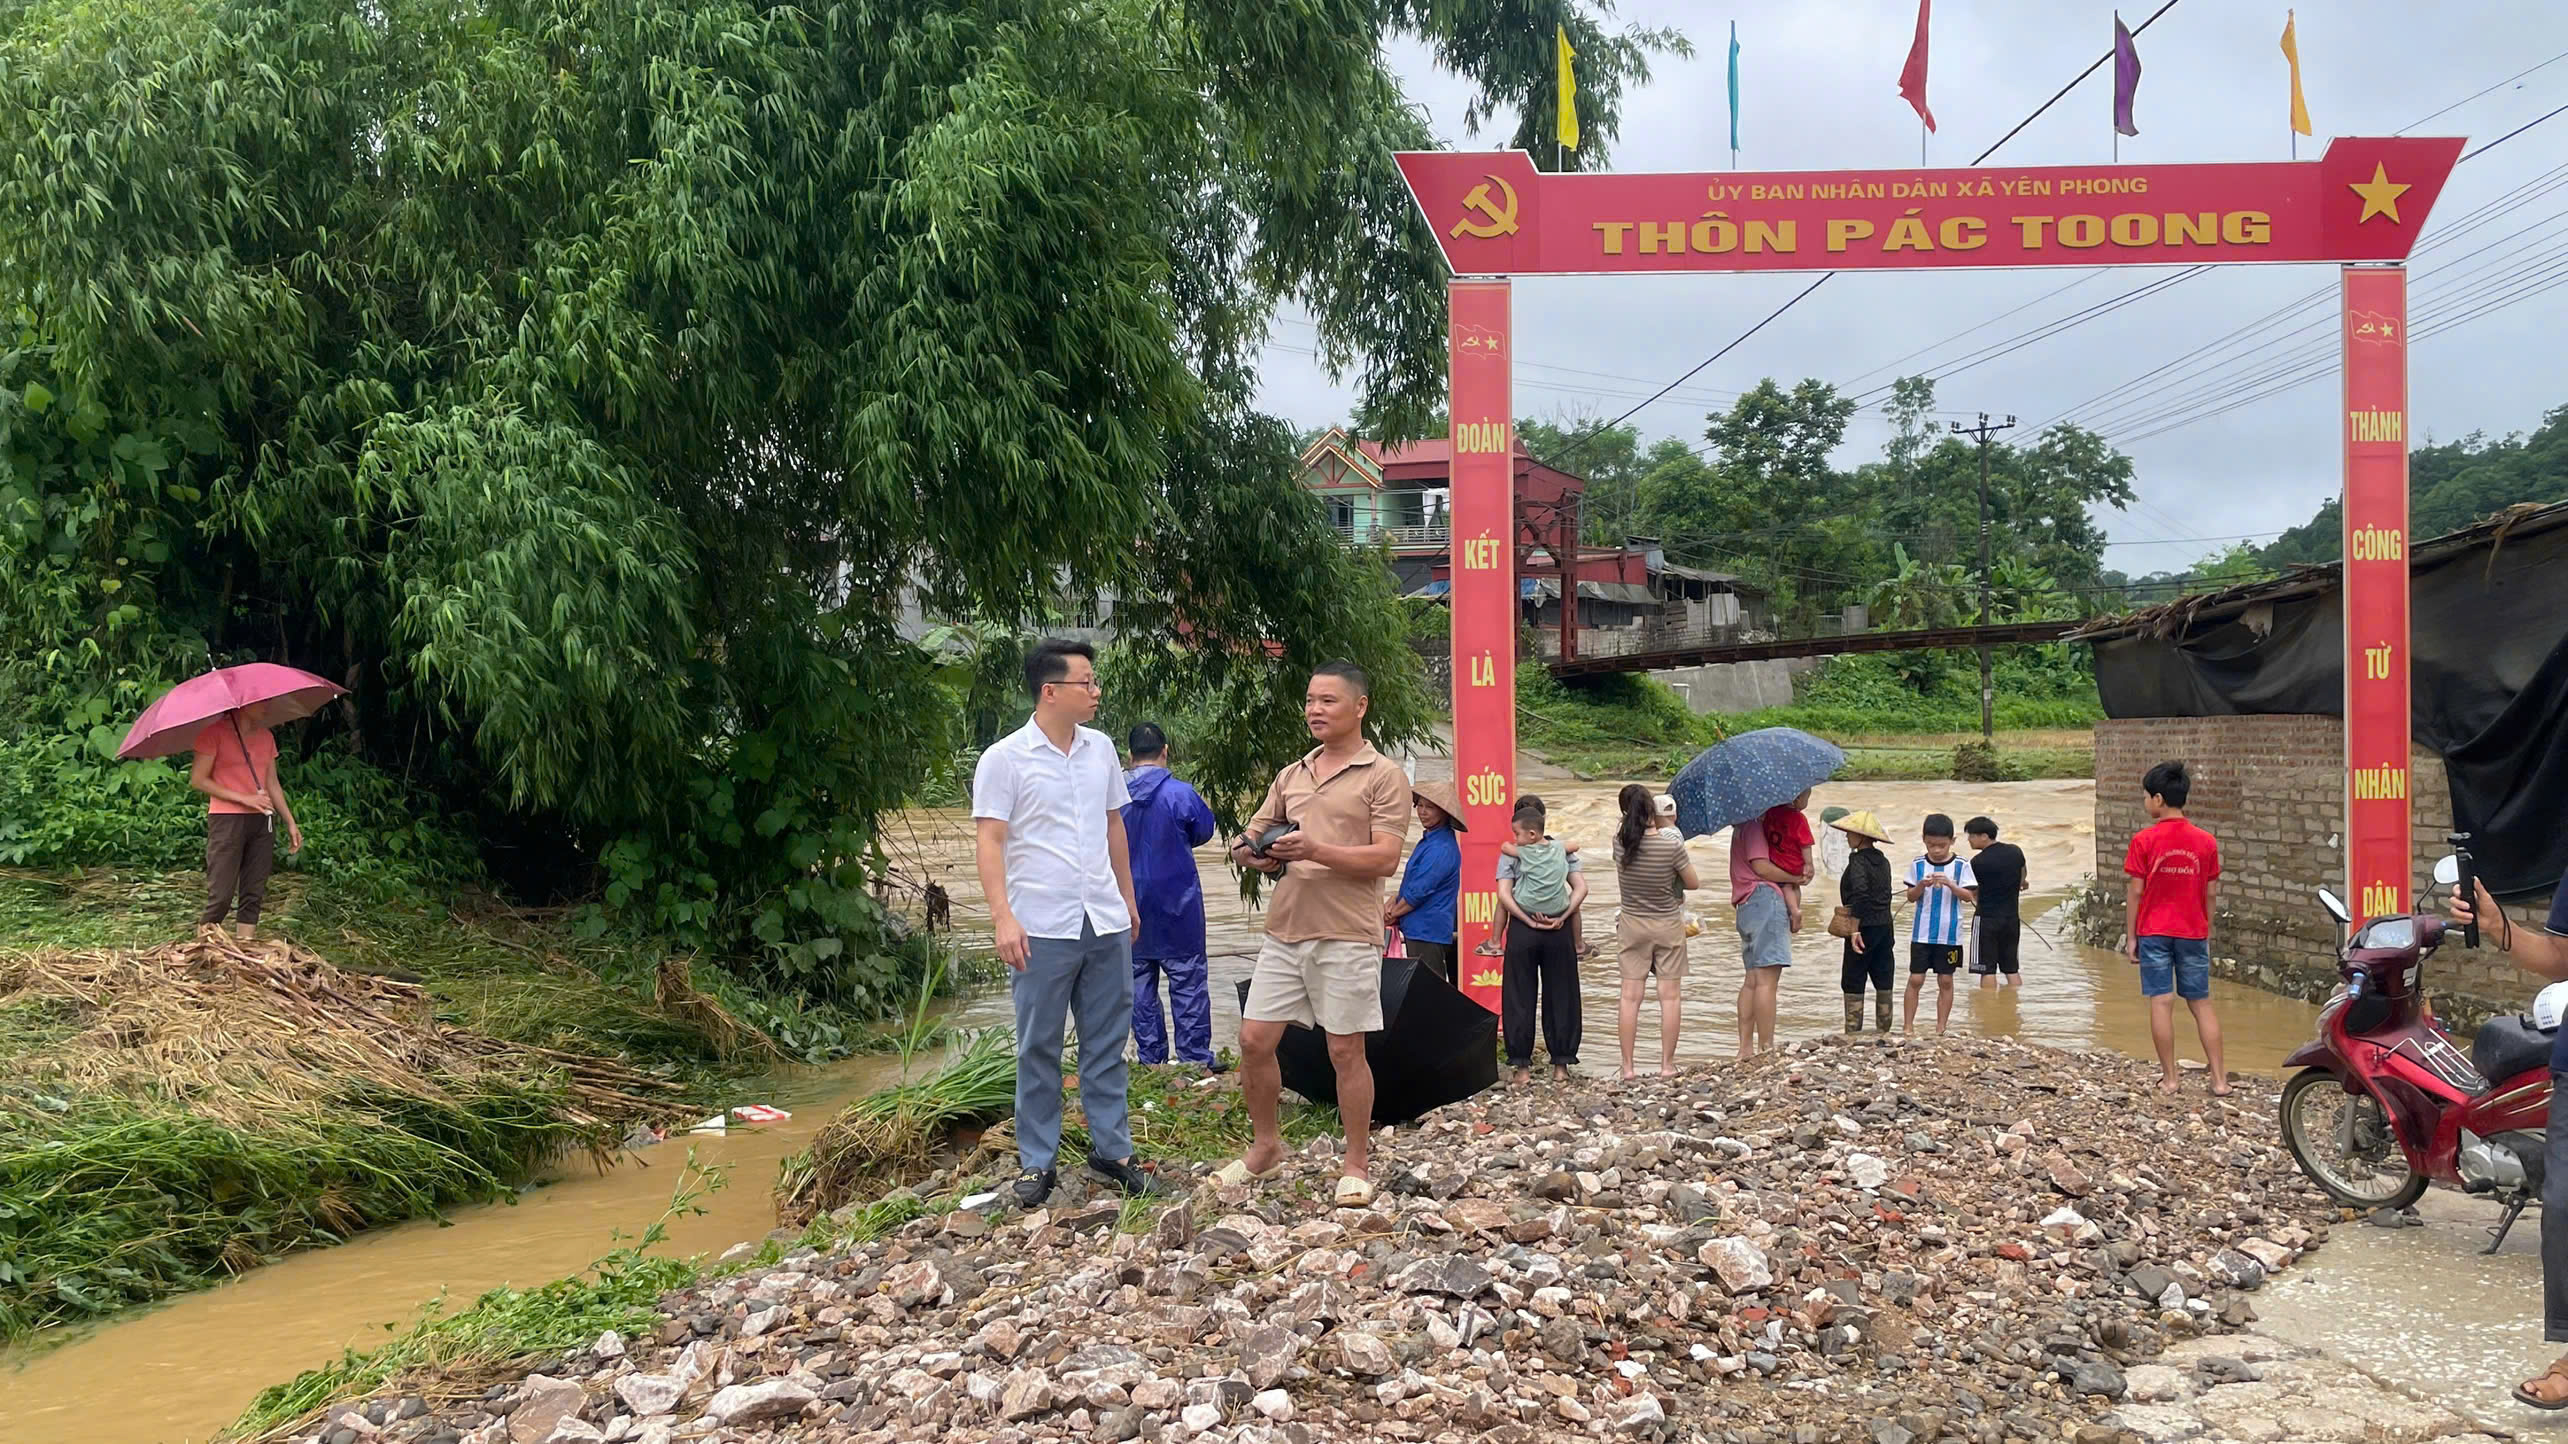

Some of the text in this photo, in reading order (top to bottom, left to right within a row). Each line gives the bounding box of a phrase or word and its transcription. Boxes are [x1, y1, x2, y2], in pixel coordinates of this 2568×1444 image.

[1708, 175, 2148, 200] ỦY BAN NHÂN DÂN XÃ YÊN PHONG
[1592, 207, 2271, 255] THÔN PÁC TOONG
[1456, 417, 1505, 453] ĐOÀN
[1464, 528, 1500, 569] KẾT
[1471, 650, 1496, 687] LÀ
[2350, 405, 2406, 918] THÀNH CÔNG TỪ NHÂN DÂN
[1466, 766, 1506, 806] SỨC
